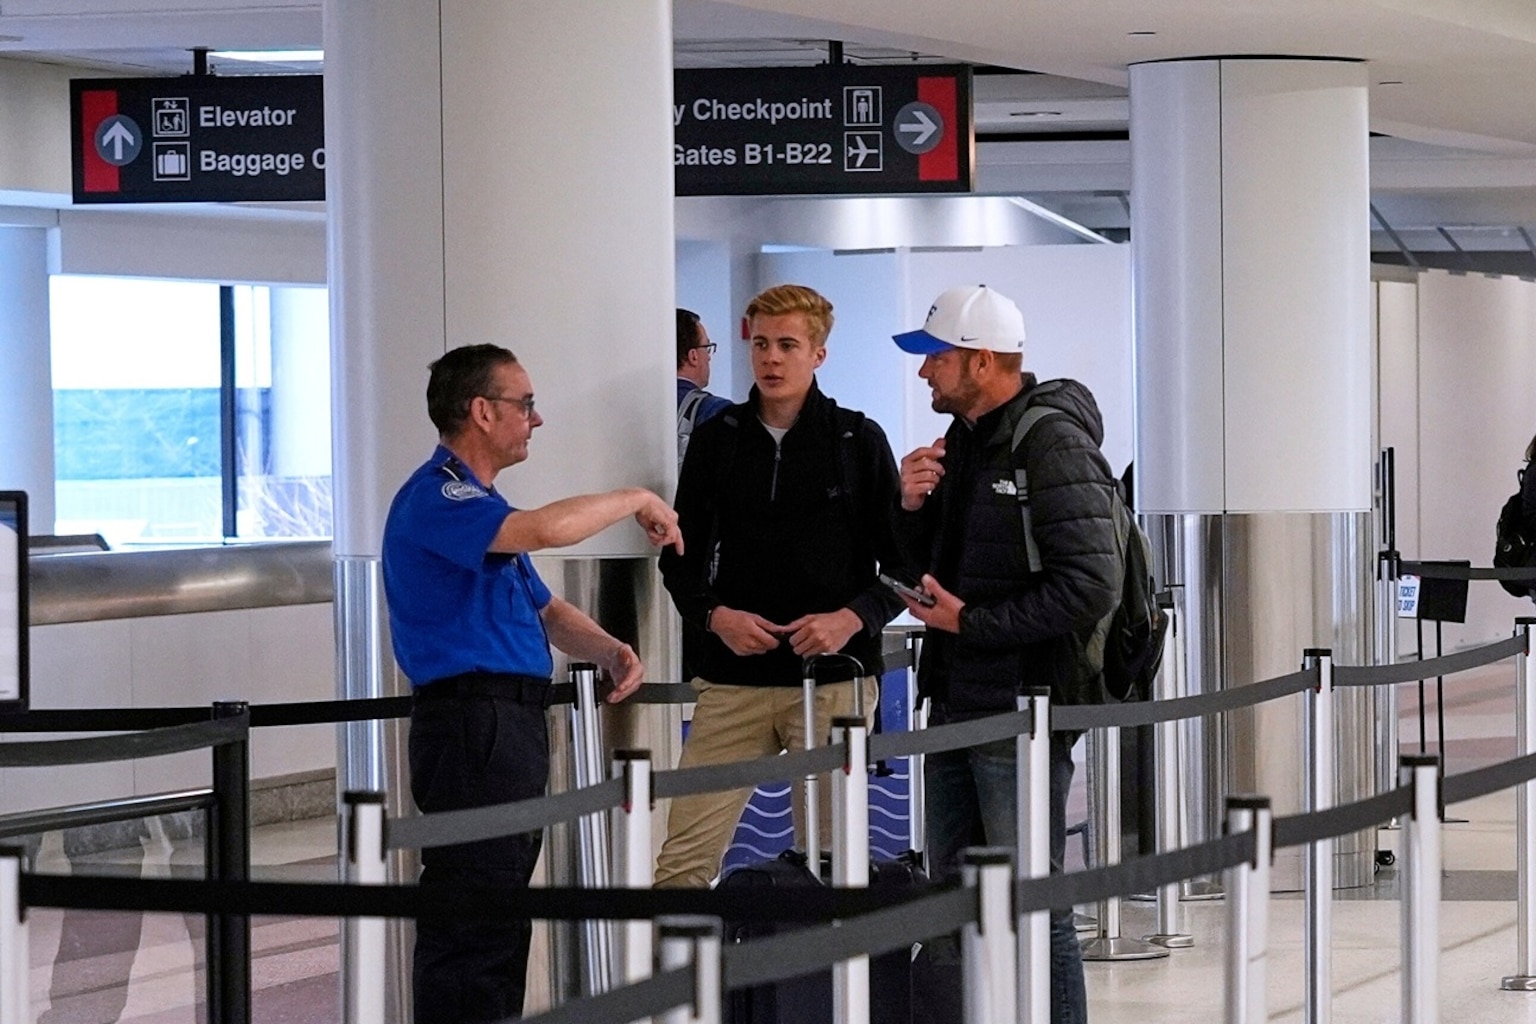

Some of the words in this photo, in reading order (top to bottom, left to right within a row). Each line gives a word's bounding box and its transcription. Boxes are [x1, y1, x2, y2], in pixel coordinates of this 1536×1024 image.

[199, 106, 296, 127] Elevator
[692, 98, 832, 124] Checkpoint
[200, 150, 305, 176] Baggage
[674, 143, 737, 166] Gates
[744, 143, 832, 165] B1-B22
